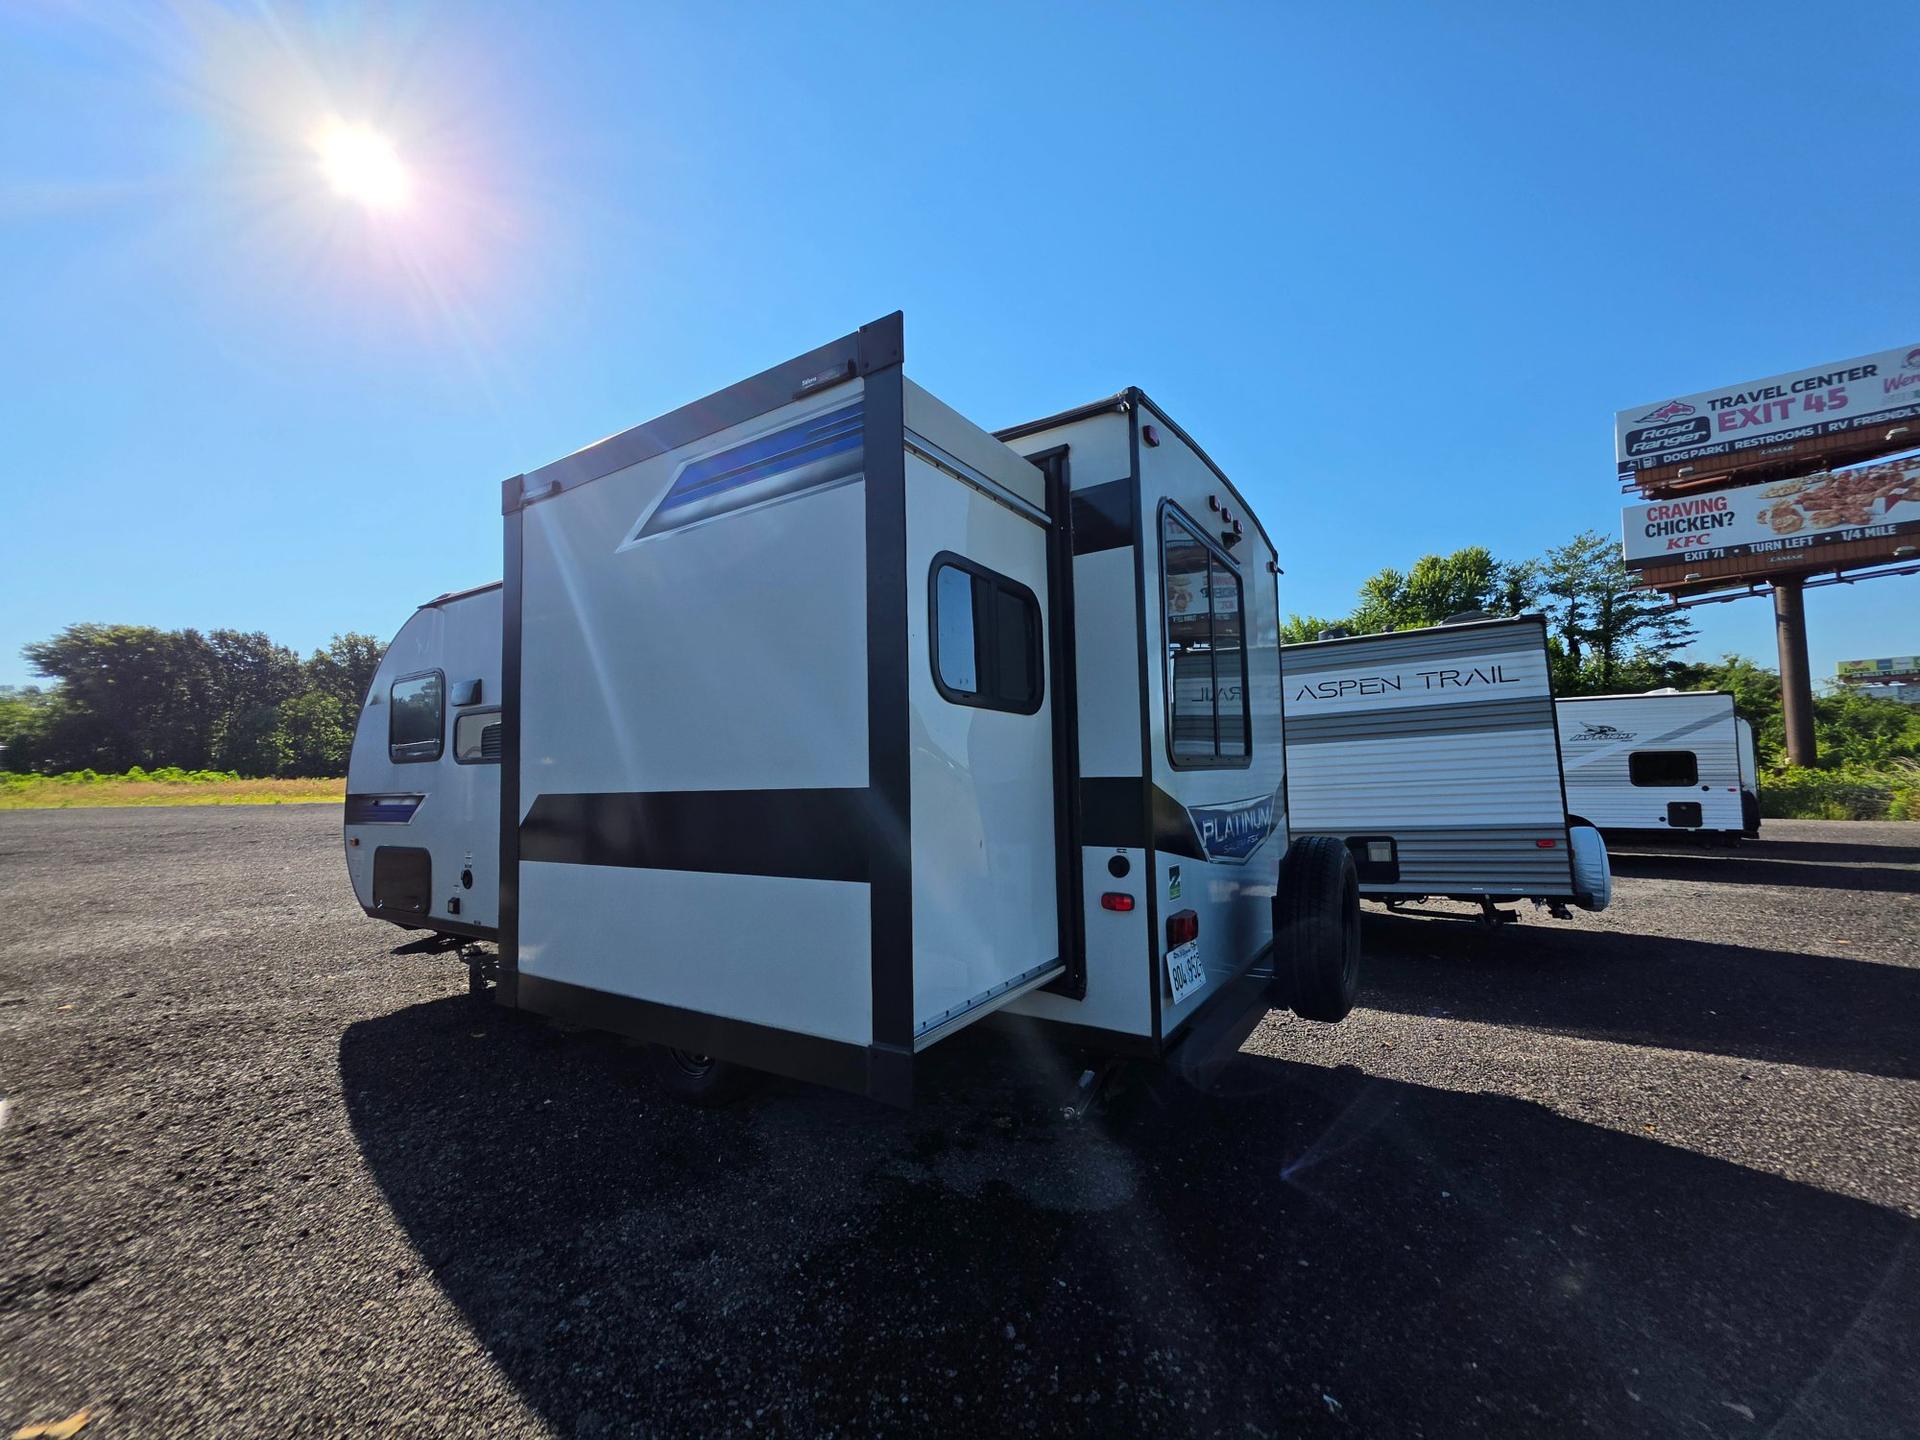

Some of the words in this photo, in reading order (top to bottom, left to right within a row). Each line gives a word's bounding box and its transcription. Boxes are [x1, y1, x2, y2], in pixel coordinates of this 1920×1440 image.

[1707, 382, 1788, 411] TRAVEL
[1791, 364, 1878, 393] CENTER
[1717, 397, 1795, 433] EXIT
[1803, 387, 1849, 414] 45
[1631, 431, 1707, 453] Ranger
[1640, 421, 1696, 441] Road
[1663, 450, 1689, 463] DOG
[1690, 445, 1724, 458] PARK
[1734, 425, 1815, 449] RESTROOMS
[1828, 419, 1849, 432] RV
[1644, 511, 1735, 538] CHICKEN?
[1647, 496, 1728, 522] CRAVING
[1666, 533, 1711, 550] KFC
[1684, 550, 1711, 563] EXIT
[1713, 548, 1724, 560] 71
[1749, 540, 1782, 554] TURN
[1785, 535, 1813, 549] LEFT
[1841, 527, 1862, 541] 1/4
[1864, 524, 1897, 539] MILE
[1296, 675, 1401, 701] ASPEN
[1416, 665, 1520, 690] TRAIL
[1202, 806, 1270, 848] PLATINUM
